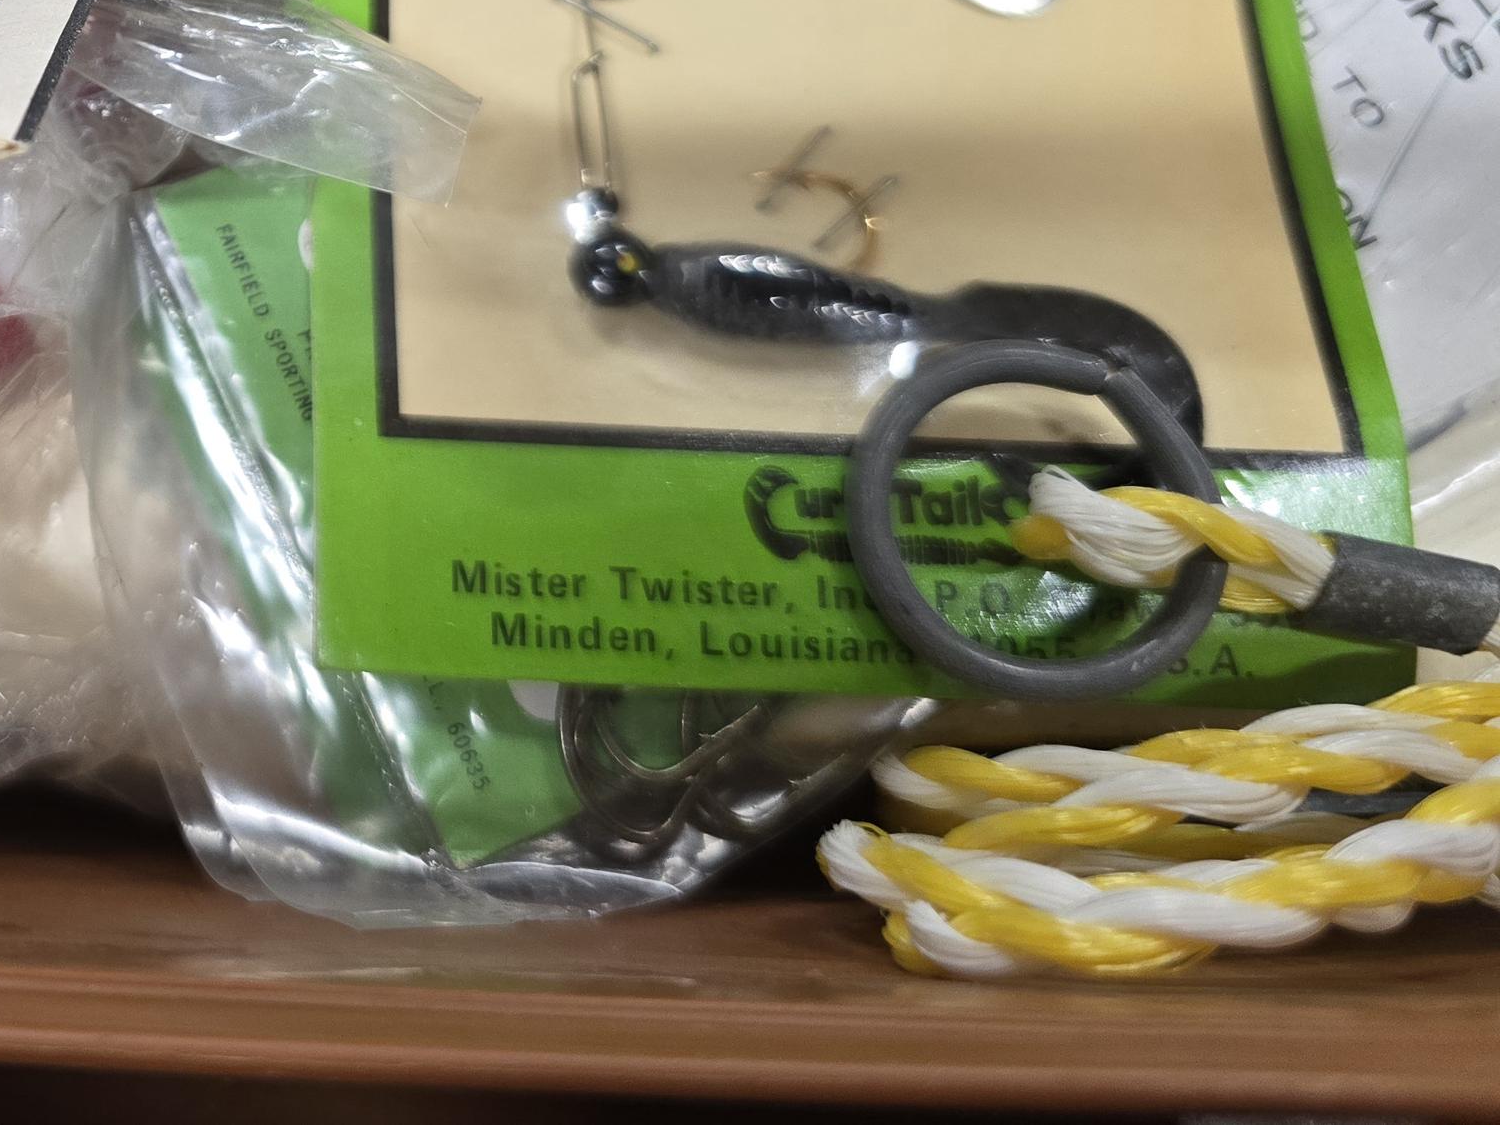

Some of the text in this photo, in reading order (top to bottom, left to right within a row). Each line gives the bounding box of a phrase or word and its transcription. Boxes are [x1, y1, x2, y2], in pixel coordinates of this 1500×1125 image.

[1332, 65, 1386, 128] TO
[215, 222, 270, 318] FAIRFIELD
[451, 559, 587, 599] Mister
[607, 565, 794, 614] Twister,
[490, 611, 674, 660] Minden,
[447, 721, 491, 790] 60635
